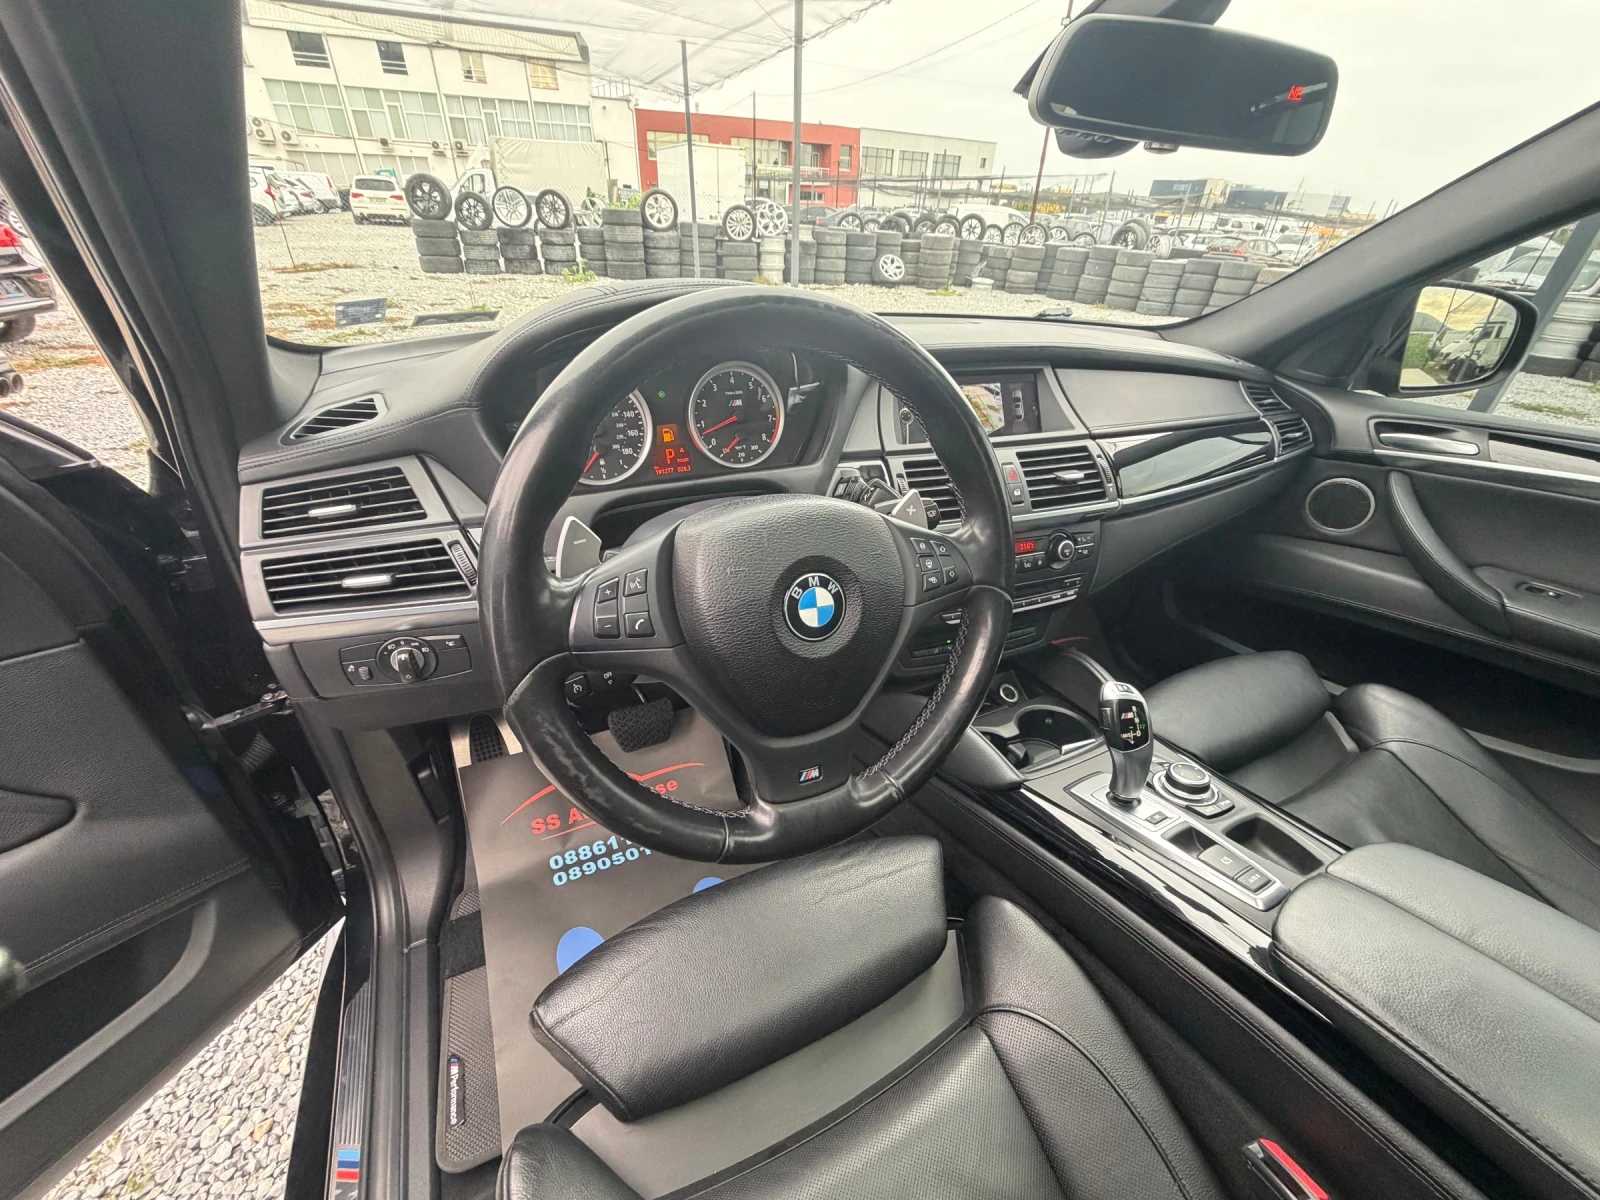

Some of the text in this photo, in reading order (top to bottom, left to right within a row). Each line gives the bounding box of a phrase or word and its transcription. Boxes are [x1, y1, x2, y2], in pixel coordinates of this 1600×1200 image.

[729, 376, 735, 385] 4
[712, 383, 718, 391] 3
[748, 381, 754, 390] 5
[761, 394, 767, 403] 6
[702, 399, 707, 408] 2
[623, 410, 635, 418] 140
[627, 429, 639, 437] 160
[761, 433, 767, 441] 8
[711, 437, 717, 446] 0
[621, 447, 633, 455] 180
[665, 448, 676, 464] P
[791, 576, 839, 600] BMW
[531, 813, 561, 835] SS
[549, 835, 633, 870] 08861
